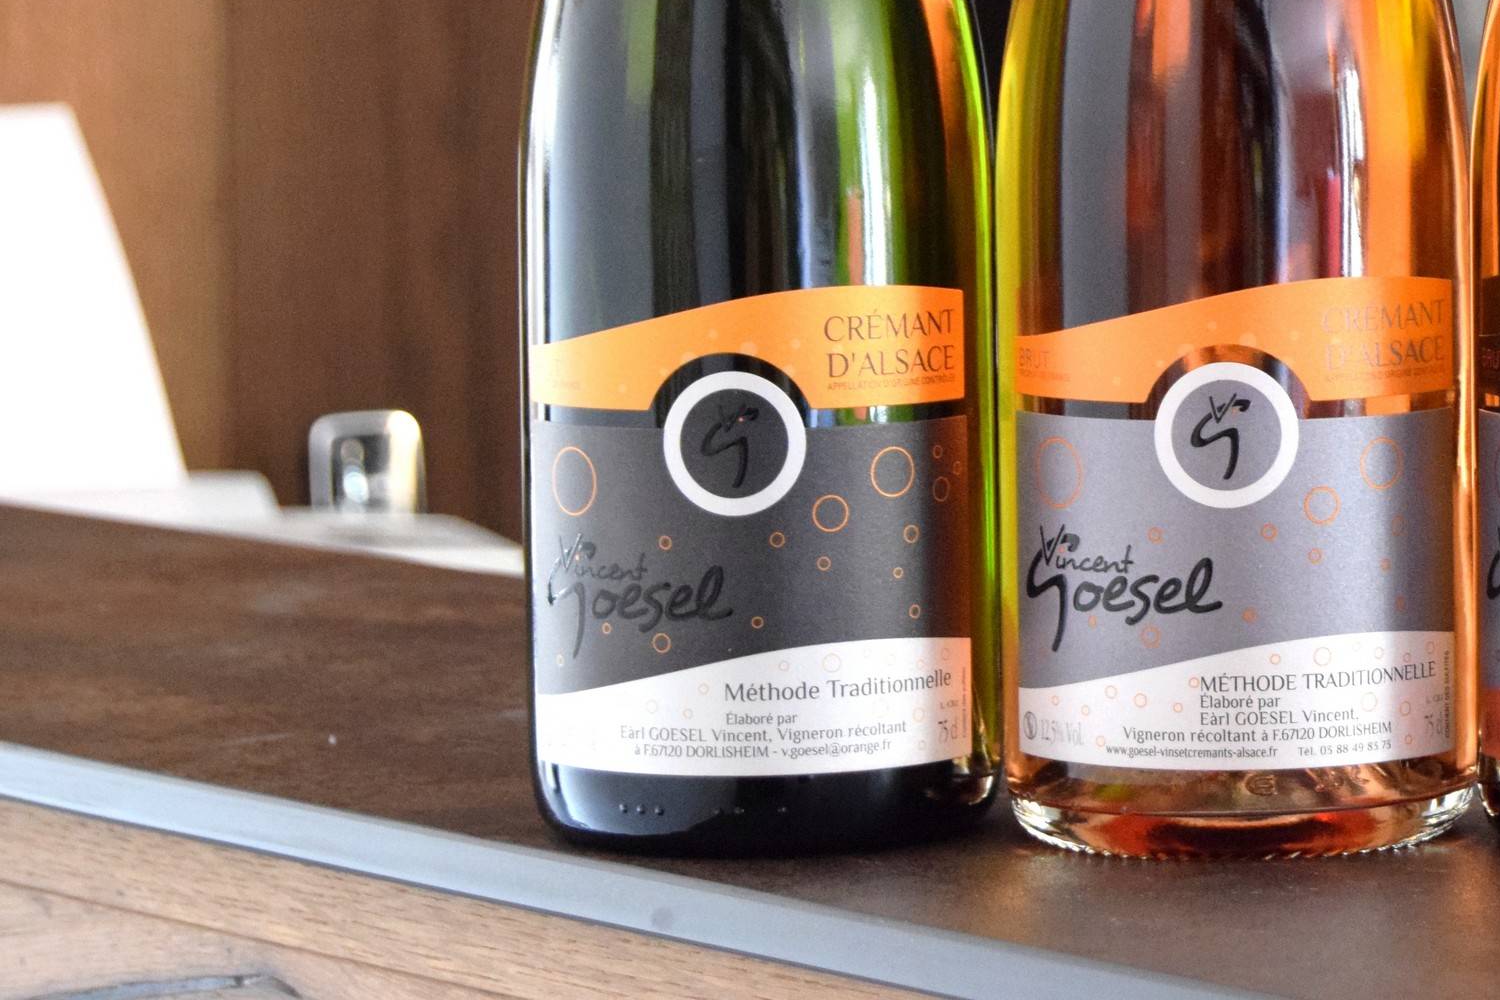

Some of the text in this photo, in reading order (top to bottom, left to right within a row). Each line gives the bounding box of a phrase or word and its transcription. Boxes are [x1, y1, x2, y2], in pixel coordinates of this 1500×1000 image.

[824, 308, 955, 342] CRÉMANT
[826, 345, 955, 378] D'ALSACE
[559, 532, 648, 580] Vincent
[1040, 524, 1134, 573] Vincent
[724, 669, 952, 701] Méthode Traditionnelle
[1200, 661, 1436, 693] MÉTHODE TRADITIONNELLE
[1200, 695, 1281, 711] Élaboré par
[726, 711, 797, 727] Élaboré par
[1235, 710, 1297, 725] GOESEL
[649, 728, 707, 742] GOESEL
[776, 727, 843, 743] Vigneron
[848, 721, 907, 738] récoltant
[1123, 721, 1392, 744] Vigneron récoltant à F.67120 DORLISHEIM
[686, 745, 770, 758] DORLISHEIM
[782, 740, 891, 759] v.goesel@orange.fr
[1106, 745, 1278, 759] www.goesel-vinsetcremants-alsace.fr
[1336, 744, 1348, 754] 88
[1352, 742, 1363, 752] 49
